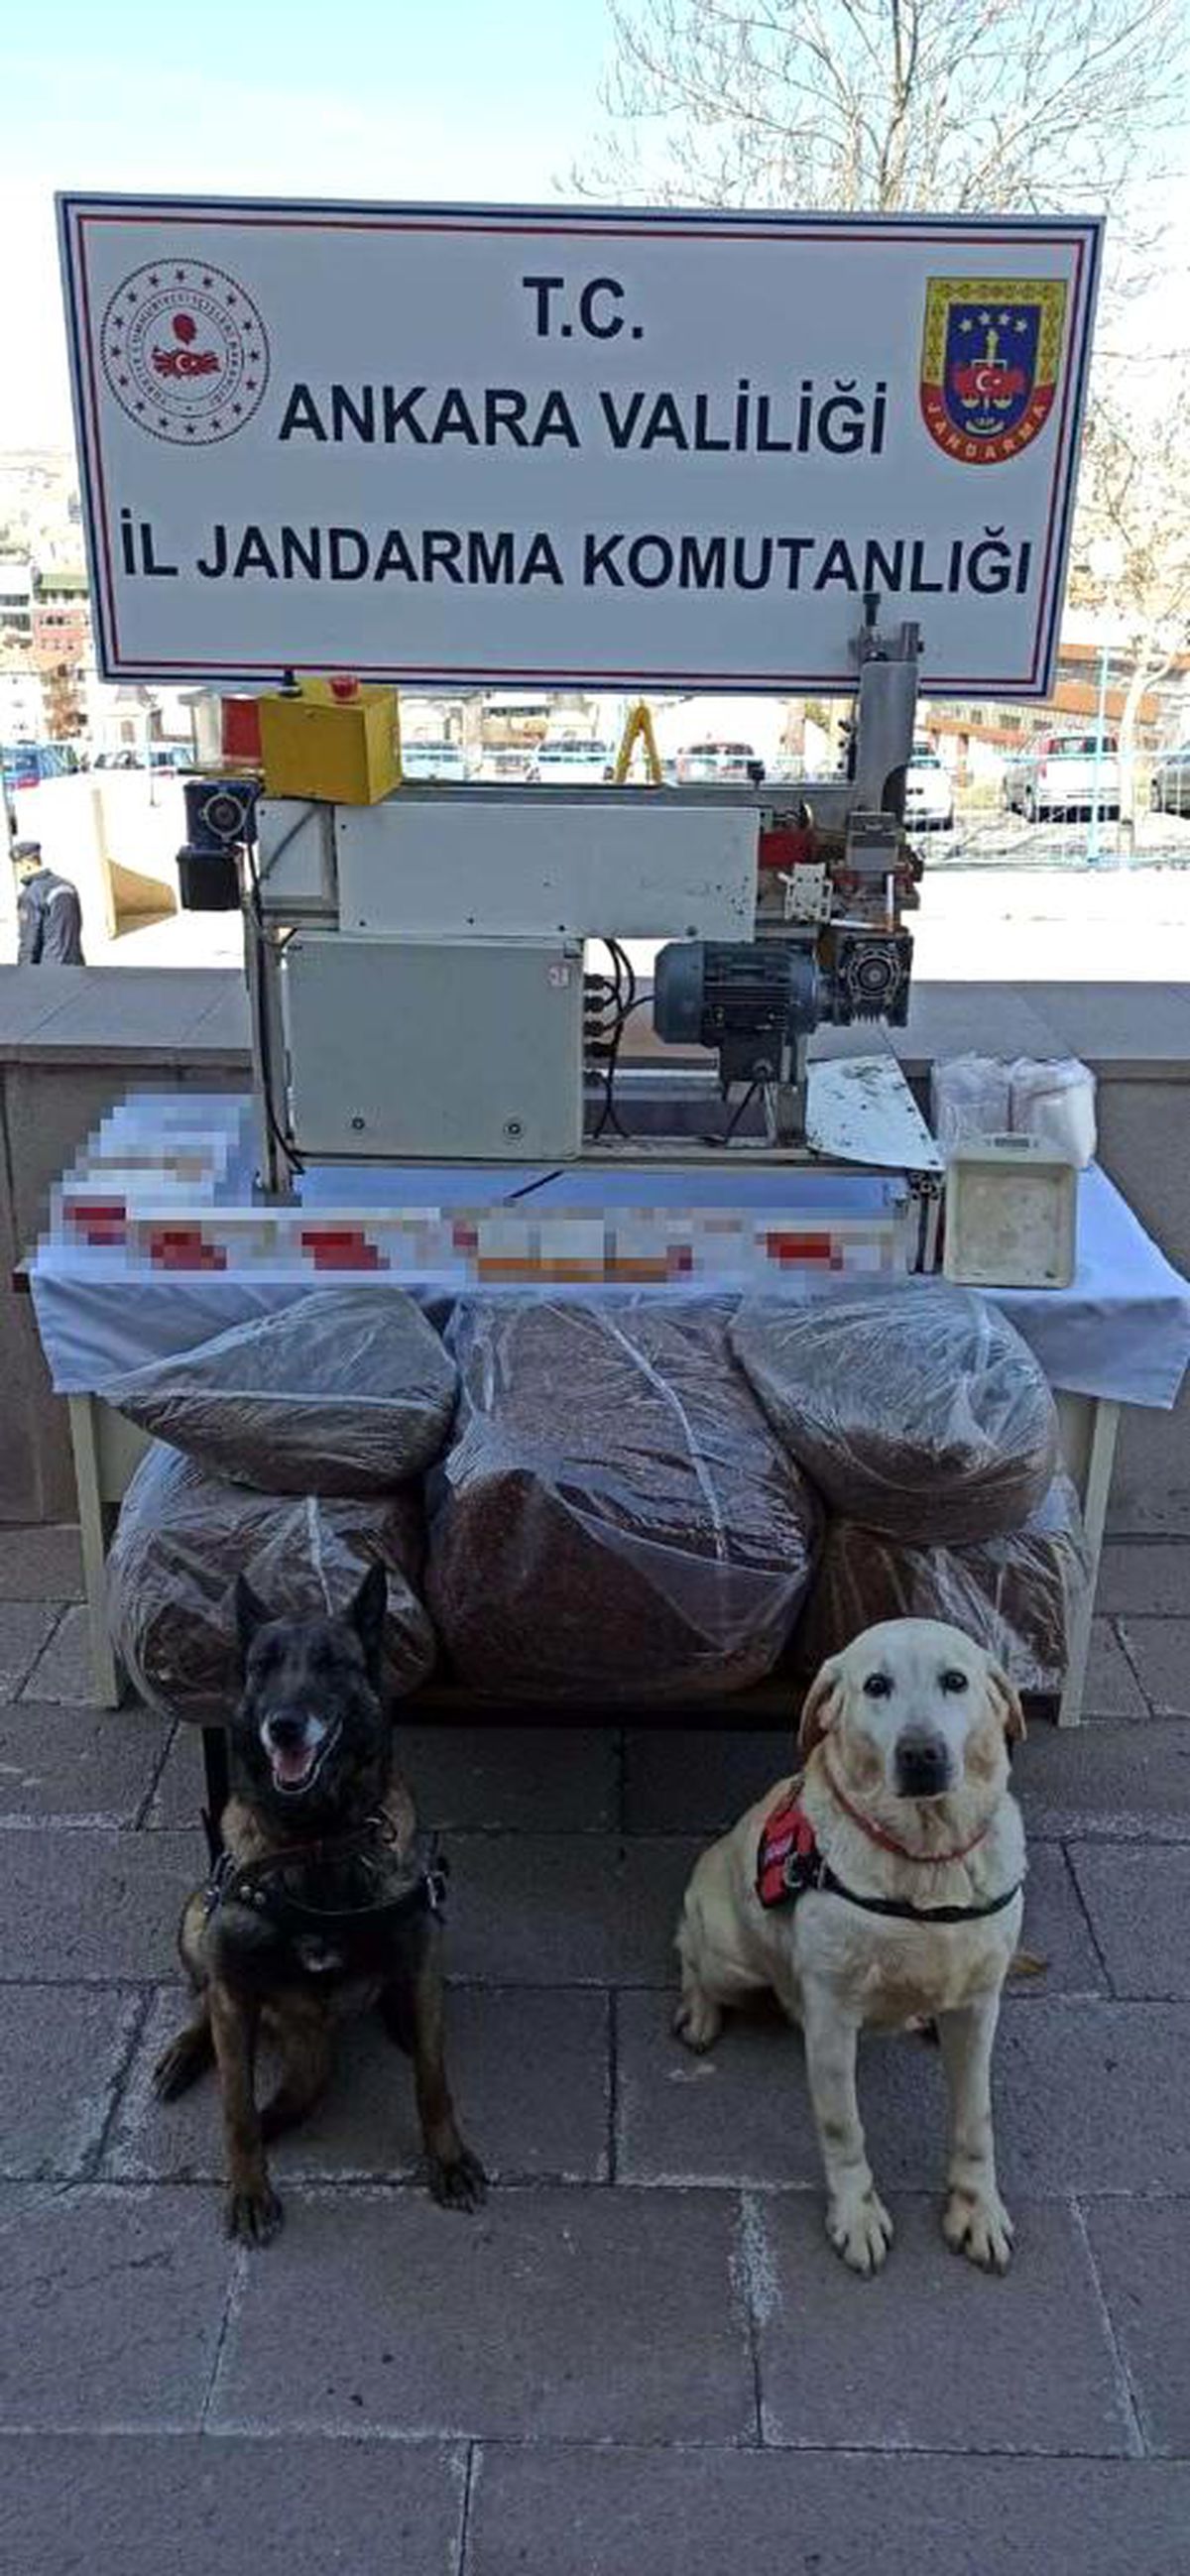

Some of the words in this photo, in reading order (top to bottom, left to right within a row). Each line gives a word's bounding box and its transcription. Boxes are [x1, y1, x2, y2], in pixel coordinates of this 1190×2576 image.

[523, 276, 644, 339] T.C.
[278, 383, 580, 448] ANKARA
[599, 379, 888, 454] VALİLİĞİ
[926, 402, 1046, 458] JANDARMA
[120, 508, 178, 576] İL
[196, 524, 564, 585] JANDARMA
[583, 526, 1032, 594] KOMUTANLIĞI
